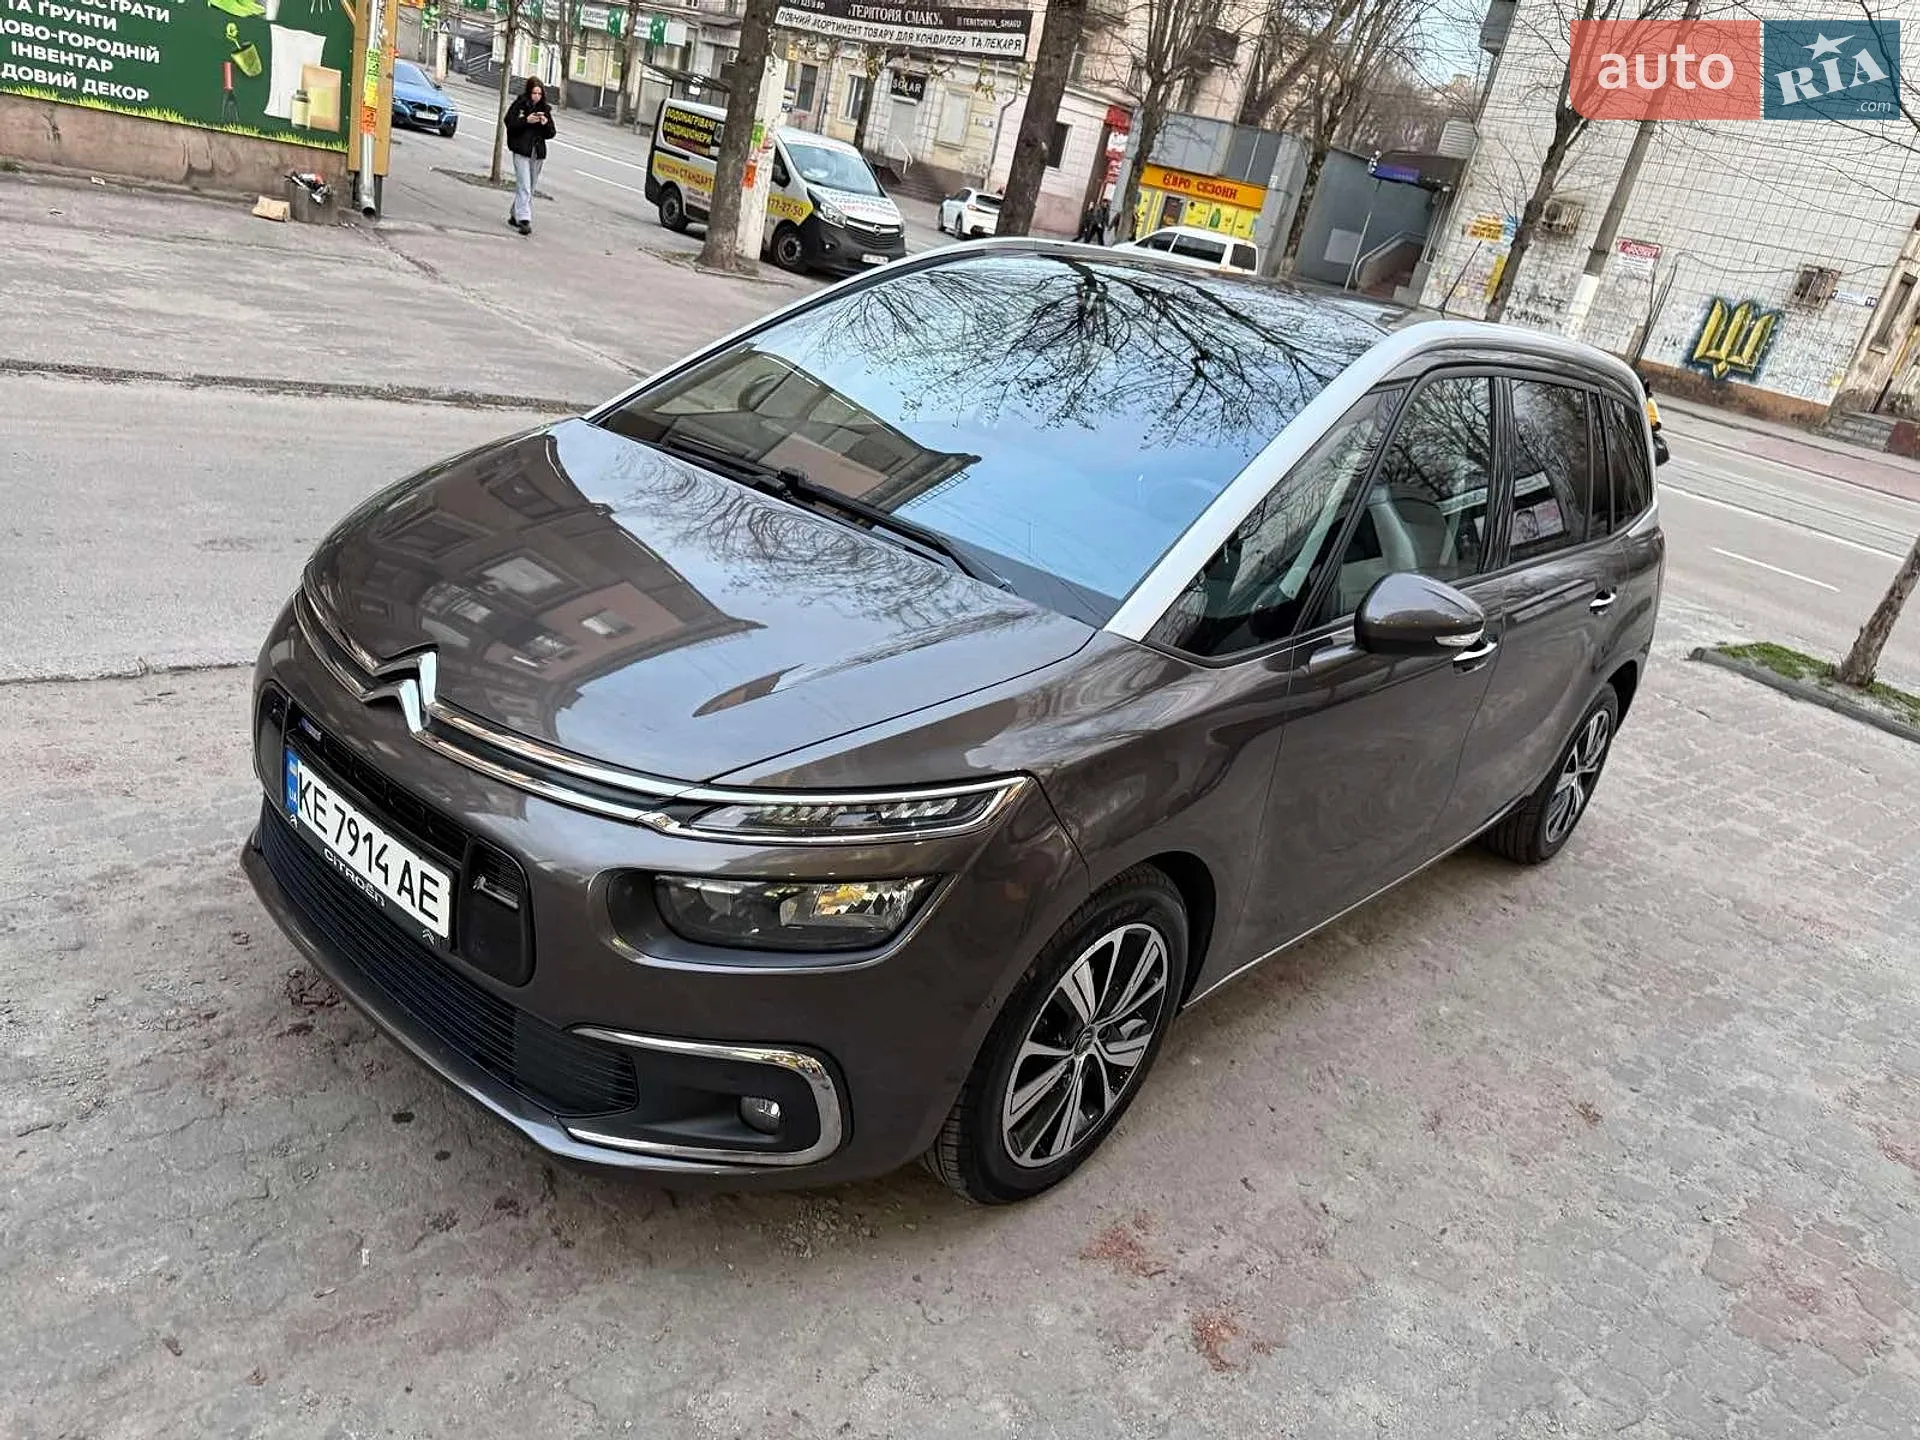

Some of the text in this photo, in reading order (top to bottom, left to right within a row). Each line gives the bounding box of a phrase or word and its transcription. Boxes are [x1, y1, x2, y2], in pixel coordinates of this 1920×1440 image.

[864, 26, 894, 41] ТОВАРУ
[896, 30, 914, 42] ДЛЯ
[11, 41, 114, 73] ІНВЕНТАР
[81, 78, 150, 102] ДЕКОР
[892, 77, 922, 93] SOLAR
[299, 771, 440, 924] KE 7914 AE
